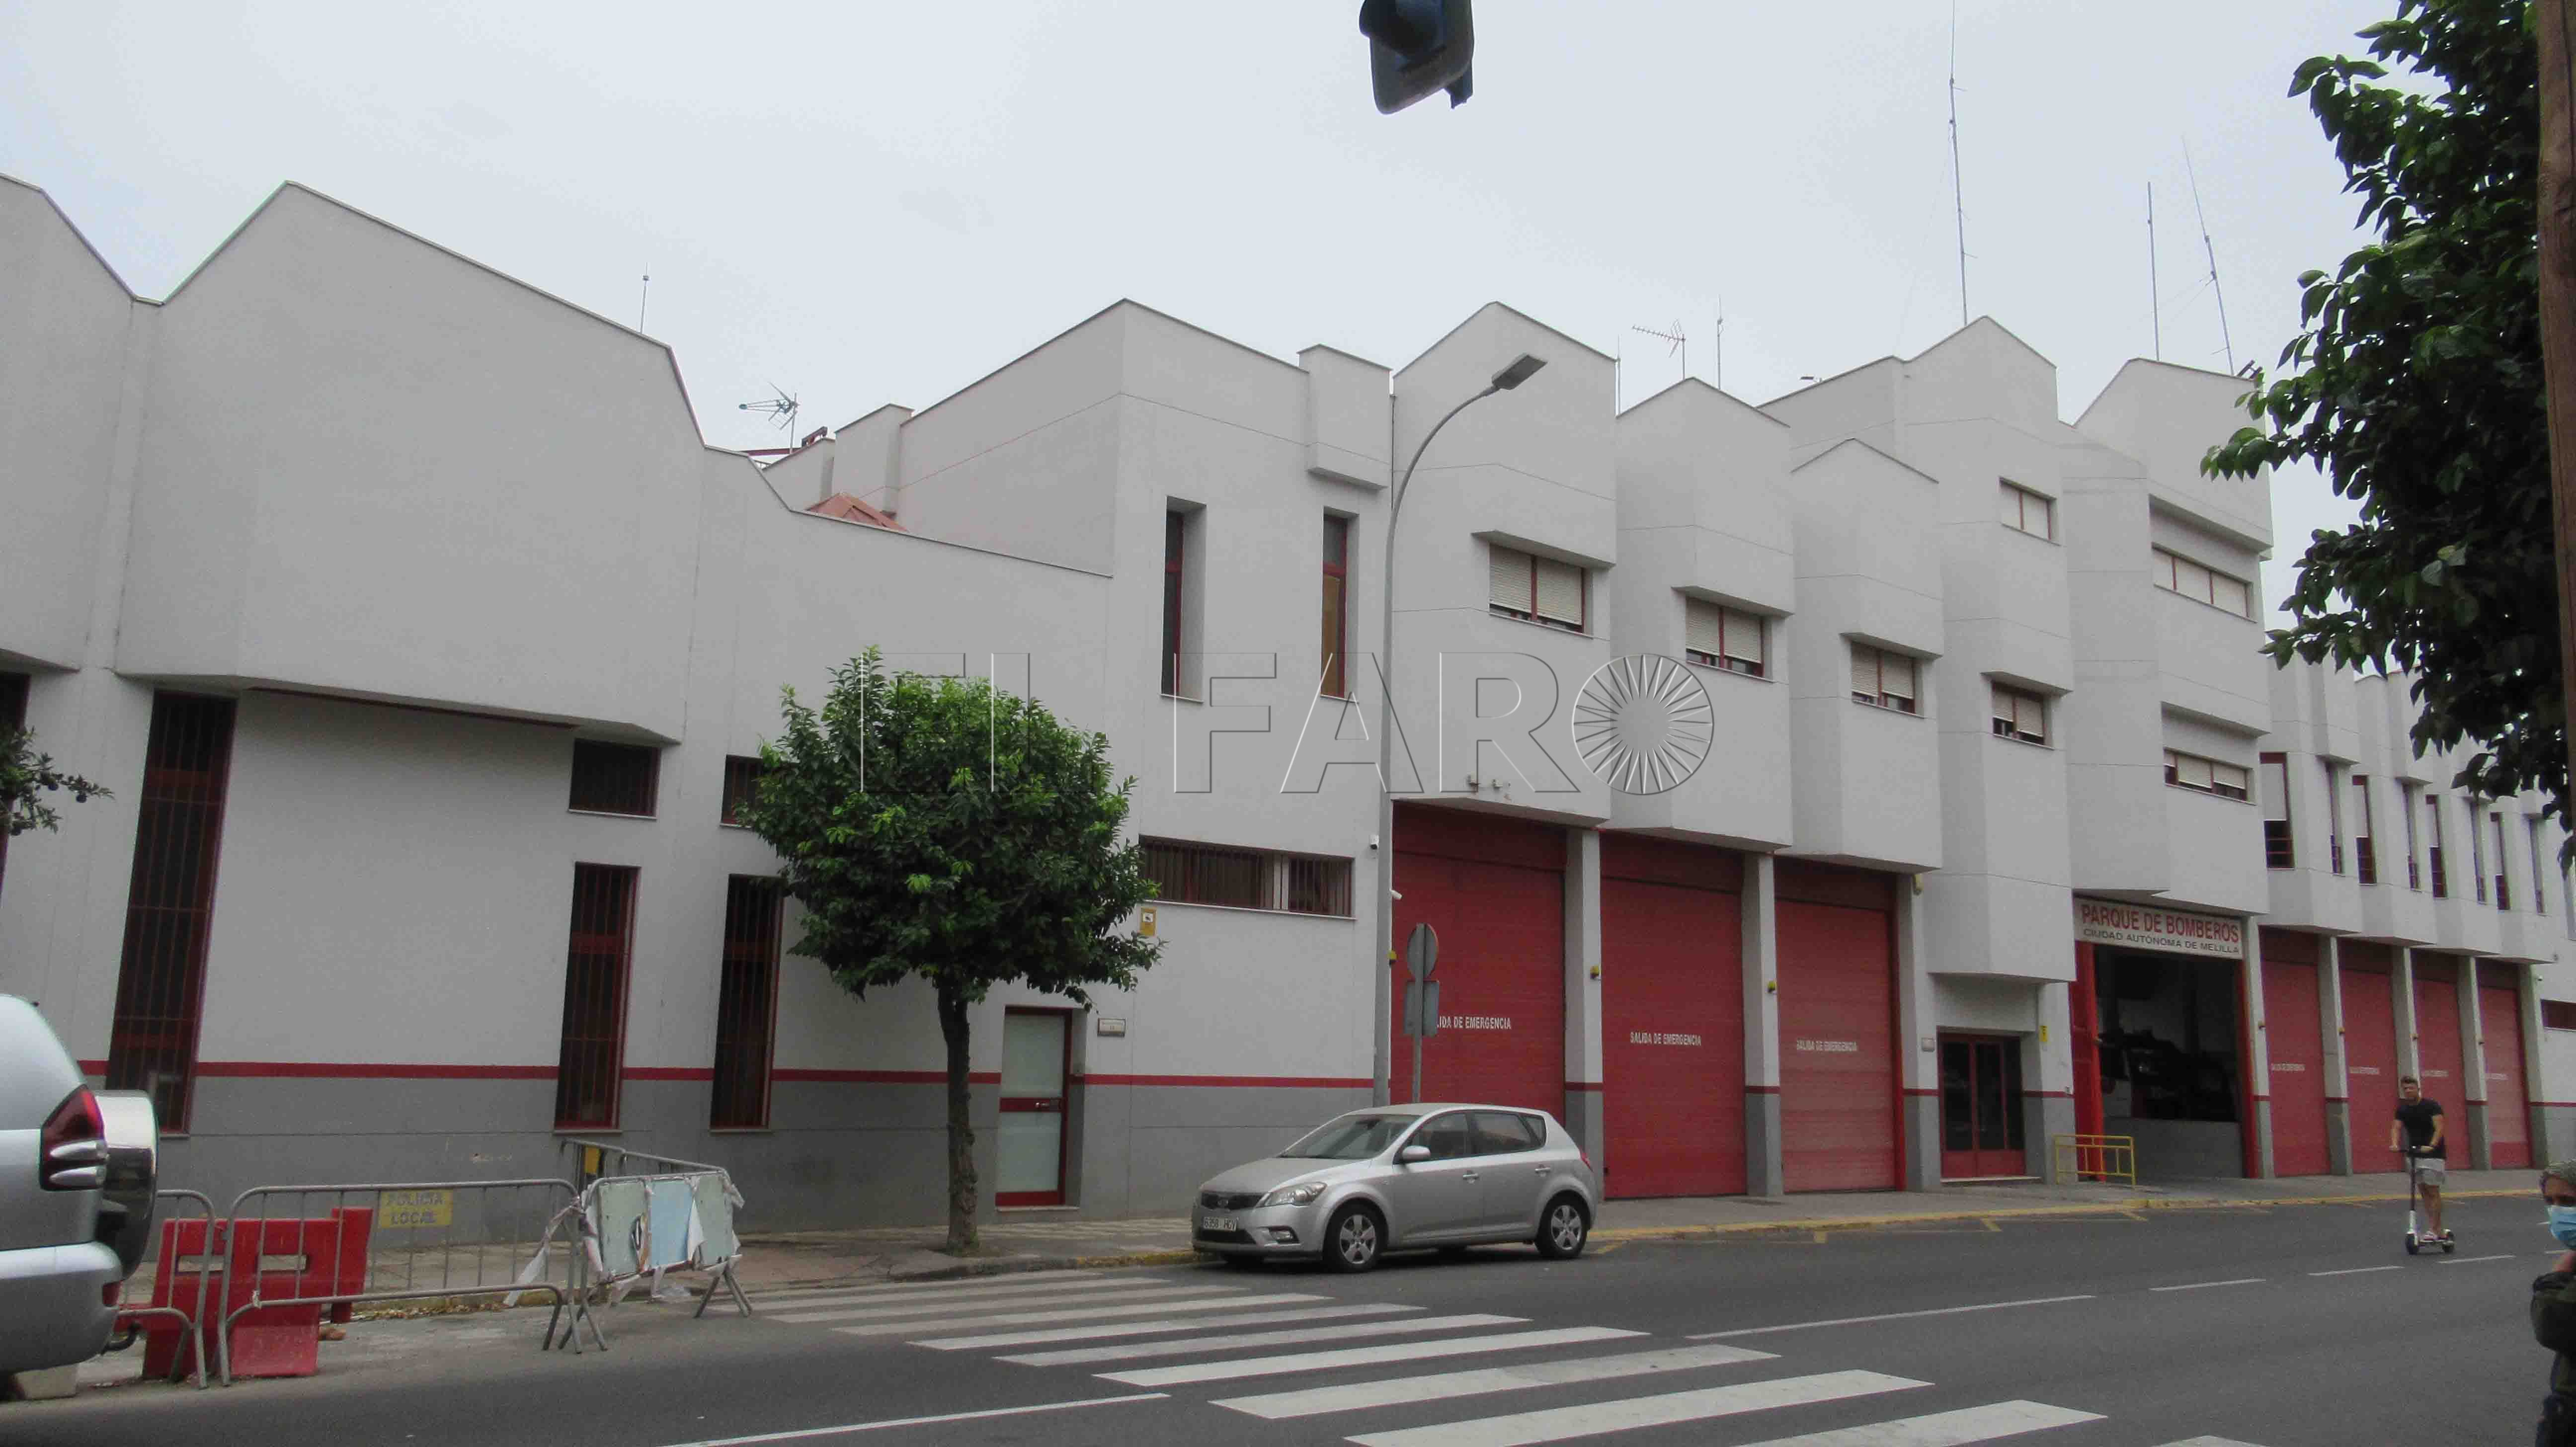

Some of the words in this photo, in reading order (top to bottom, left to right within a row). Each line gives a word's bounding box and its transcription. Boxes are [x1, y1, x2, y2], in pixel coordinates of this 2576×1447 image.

[2082, 904, 2139, 930] PARQUE
[2144, 912, 2162, 933] DE
[2166, 915, 2239, 943] BOMBEROS
[2084, 928, 2123, 940] CIUDAD
[2185, 941, 2198, 950] DE
[2200, 943, 2239, 953] MELILLA
[1453, 1016, 1463, 1029] DE
[1465, 1016, 1511, 1030] EMERGENCIA
[1630, 1032, 1652, 1044] SALIDA
[1653, 1033, 1662, 1045] DE
[1663, 1033, 1702, 1046] EMERGENCIA
